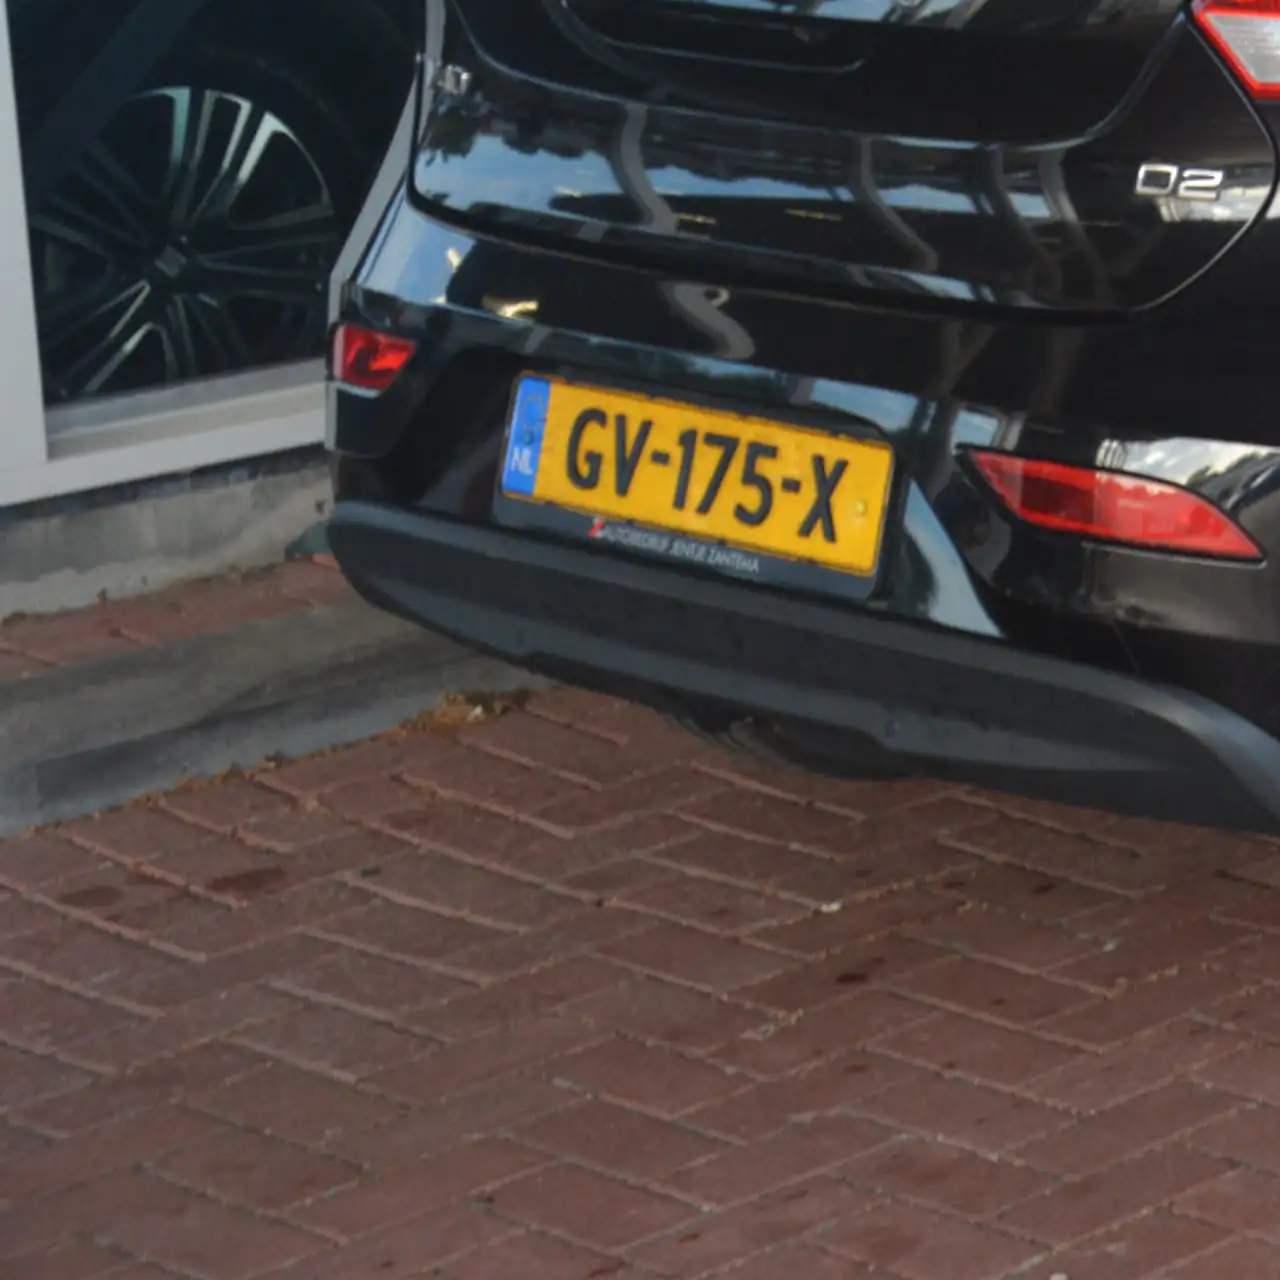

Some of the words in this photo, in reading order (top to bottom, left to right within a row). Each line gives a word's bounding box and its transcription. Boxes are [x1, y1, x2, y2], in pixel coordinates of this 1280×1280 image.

[1135, 163, 1224, 201] D2
[510, 446, 534, 476] NL
[565, 408, 849, 544] GV-175-X
